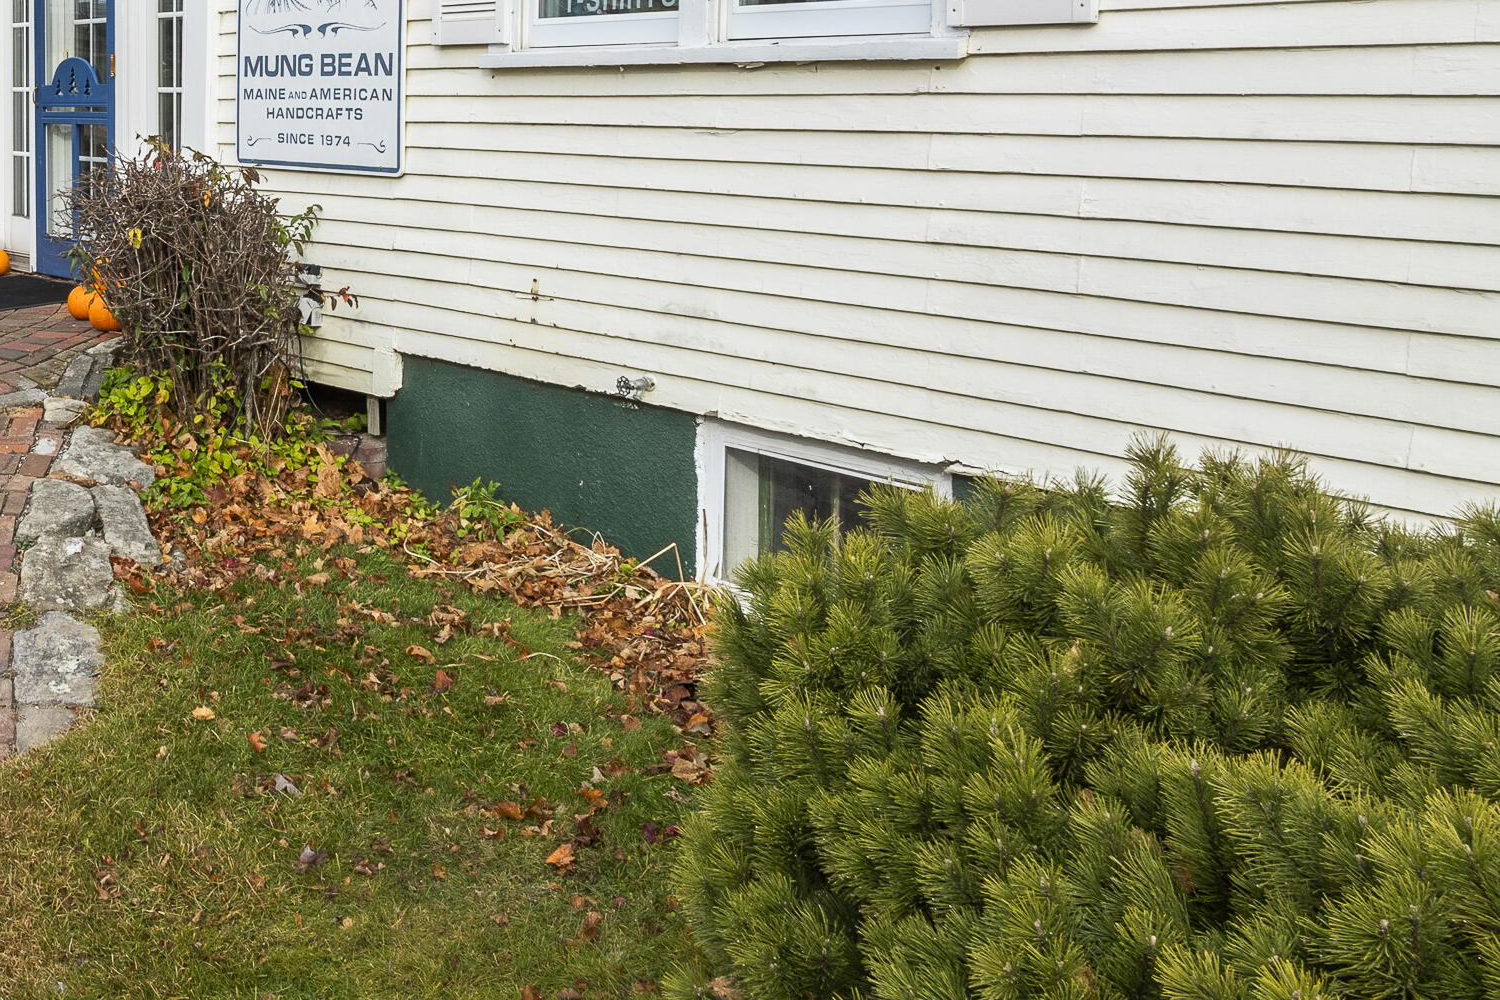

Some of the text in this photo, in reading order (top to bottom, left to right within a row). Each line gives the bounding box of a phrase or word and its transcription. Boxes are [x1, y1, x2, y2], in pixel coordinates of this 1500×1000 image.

[244, 52, 394, 78] MUNG BEAN
[243, 88, 393, 101] MAINE AND AMERICAN
[266, 107, 363, 121] HANDCRAFTS
[277, 132, 351, 147] SINCE 1974
